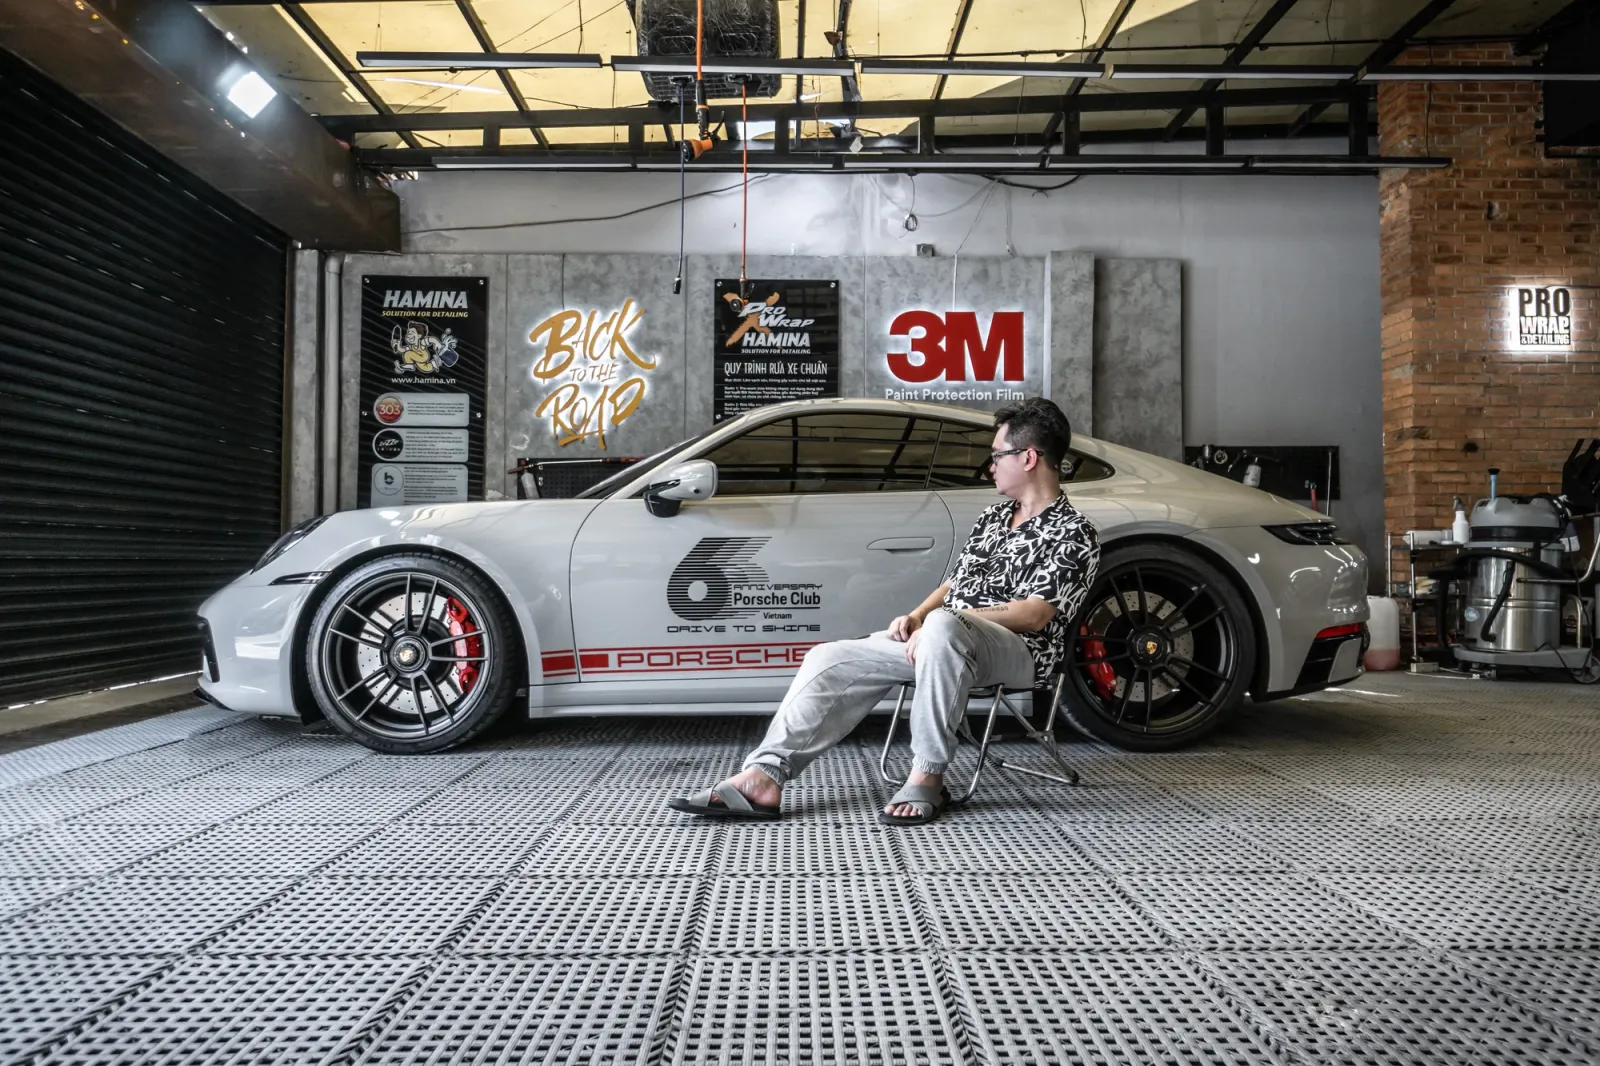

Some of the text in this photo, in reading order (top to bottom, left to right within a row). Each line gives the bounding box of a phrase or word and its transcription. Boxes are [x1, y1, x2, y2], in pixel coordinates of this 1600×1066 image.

[383, 290, 468, 309] HAMINA
[1519, 288, 1570, 316] PRO
[1520, 316, 1569, 334] WRAP
[529, 298, 657, 384] BACK
[742, 333, 811, 347] HAMINA
[887, 310, 1024, 383] 3M
[570, 363, 620, 382] TO THE
[724, 362, 742, 377] QUY
[744, 360, 767, 375] TRÌNH
[788, 362, 799, 375] XE
[391, 376, 456, 384] www.hamina.vn
[885, 388, 1025, 401] Paint Protection Film
[379, 404, 401, 415] 303
[535, 377, 646, 451] ROAD
[733, 583, 823, 591] ANNIVERSARY
[734, 591, 821, 606] Porsche Club
[763, 611, 793, 620] Vietnam
[667, 625, 727, 633] DRIVE
[762, 624, 821, 632] SHINE
[617, 647, 812, 668] PORSCHE
